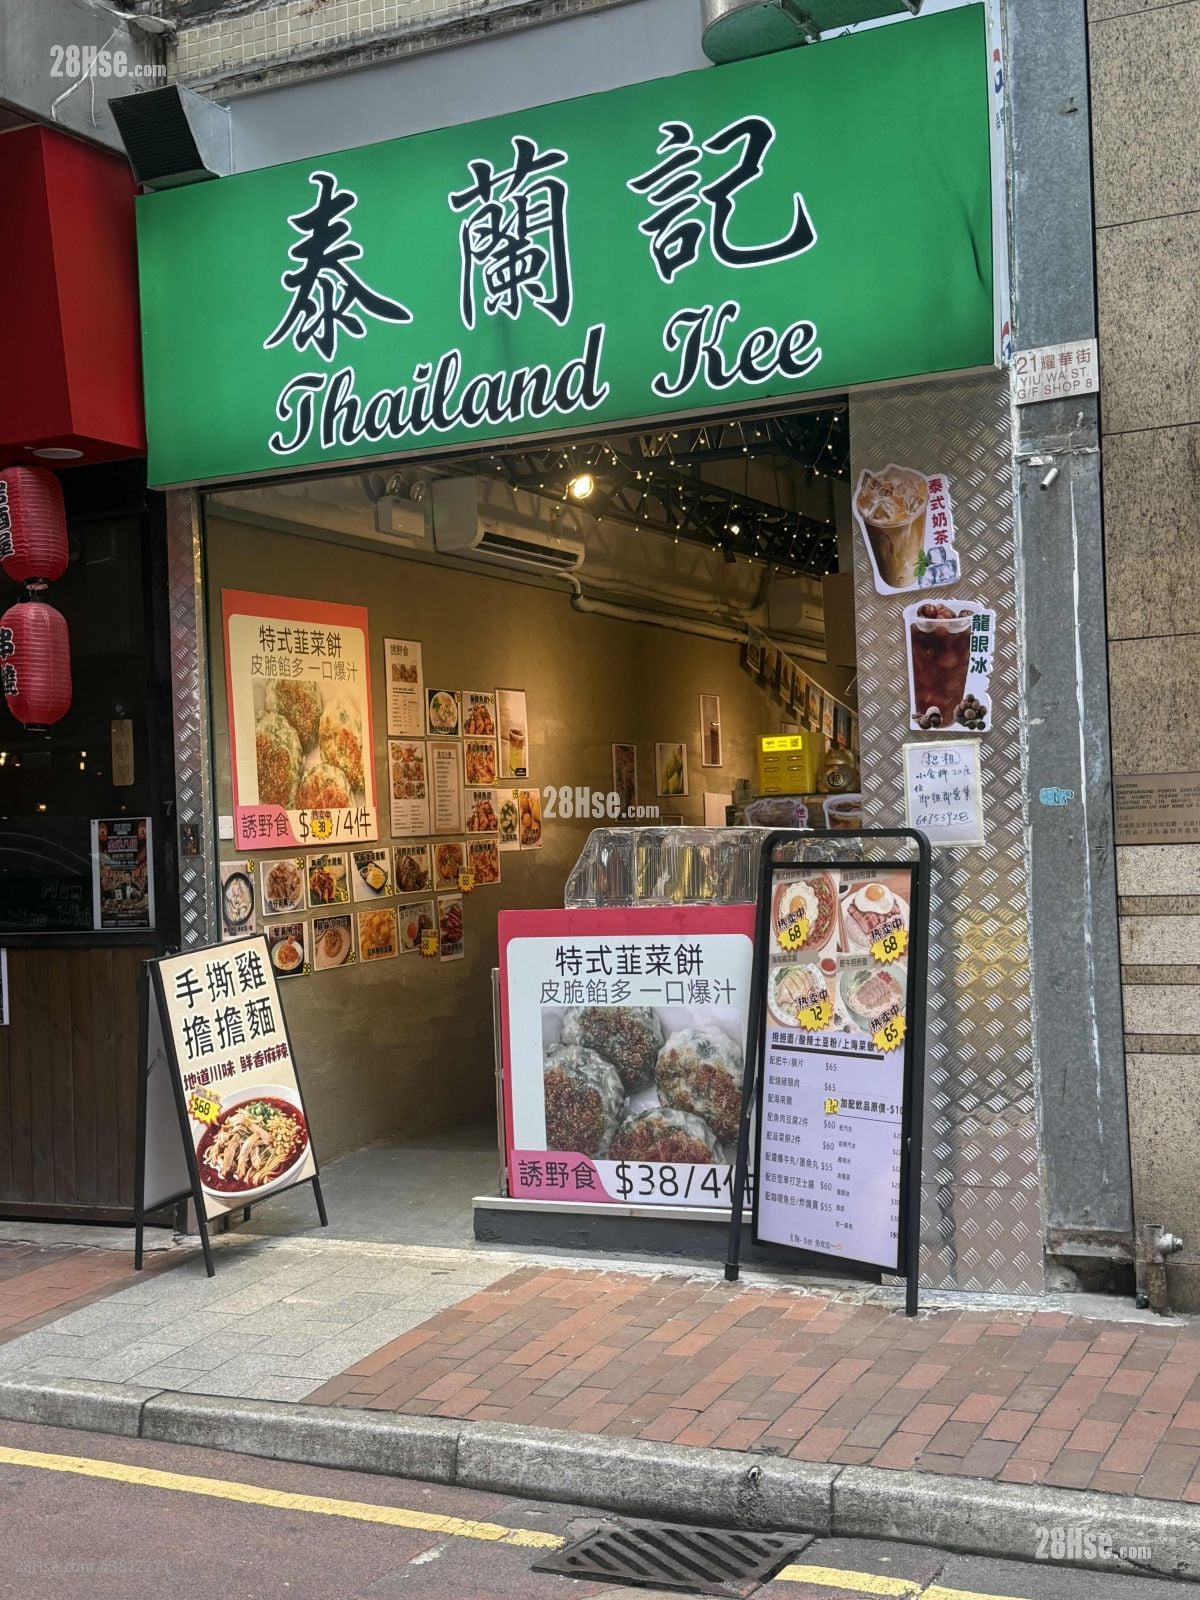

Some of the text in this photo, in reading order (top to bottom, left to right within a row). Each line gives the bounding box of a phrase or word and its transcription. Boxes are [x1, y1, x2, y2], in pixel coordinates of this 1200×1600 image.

[263, 115, 818, 361] 泰蘭記
[268, 300, 823, 455] Thailand Kee
[1017, 379, 1093, 400] G/F SHOP 8
[1020, 376, 1041, 387] YIU
[1046, 371, 1066, 382] WA
[927, 478, 949, 545] 泰式奶茶
[970, 614, 990, 674] 龍眼冰
[250, 653, 358, 683] 皮脆餡多 一口爆汁
[241, 812, 289, 839] 誘野食
[175, 950, 267, 1009] 手撕雞
[539, 978, 737, 1005] 皮脆餡多 一口爆汁
[182, 996, 276, 1060] 擔擔麵
[183, 1060, 236, 1092] 地道川味
[518, 1160, 597, 1190] 誘野食
